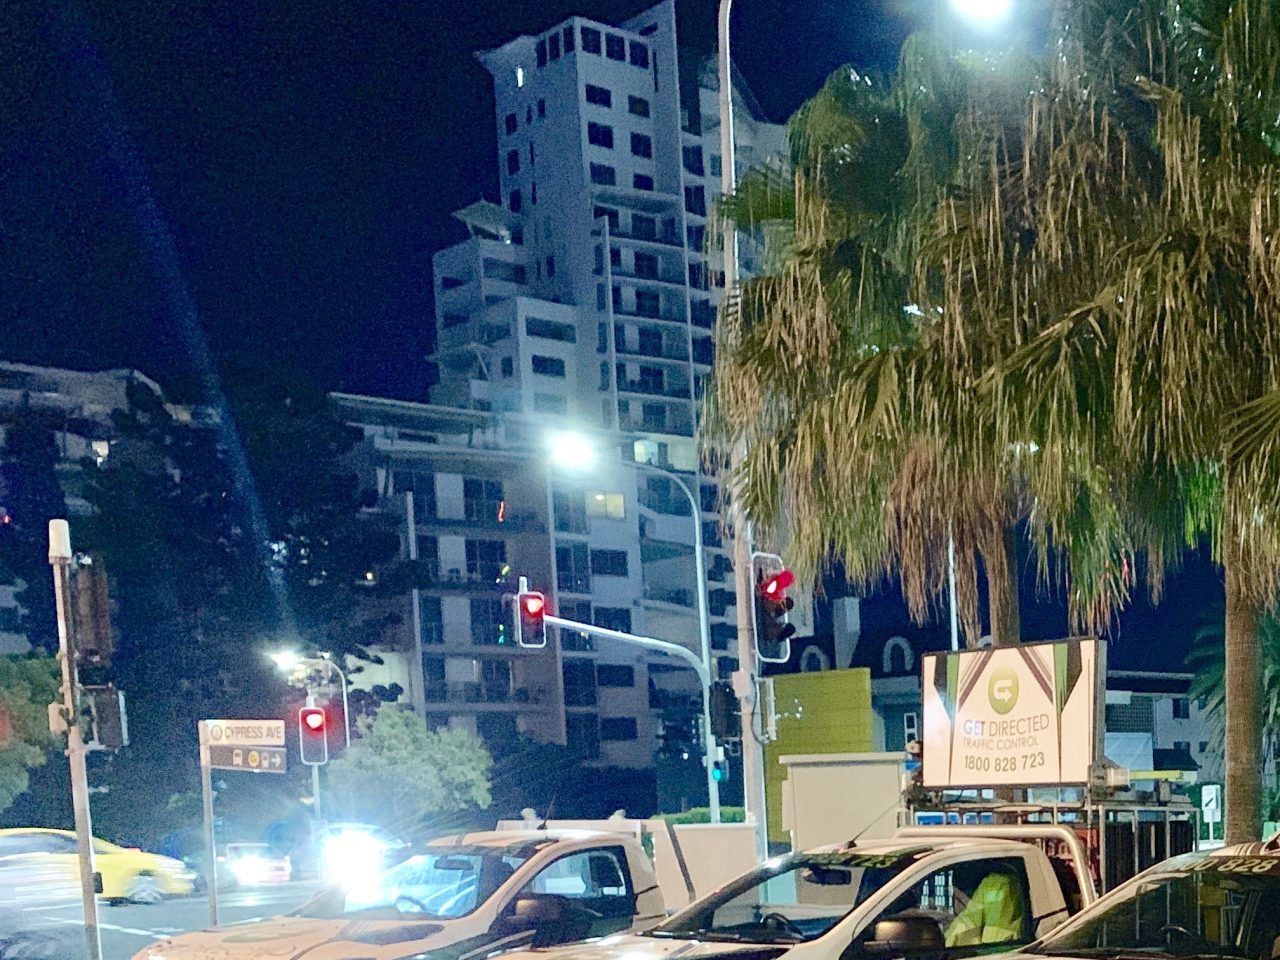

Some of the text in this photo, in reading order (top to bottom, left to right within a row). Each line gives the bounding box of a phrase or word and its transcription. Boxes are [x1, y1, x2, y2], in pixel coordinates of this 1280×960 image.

[225, 726, 281, 739] CYPRESS AVE
[963, 713, 1050, 737] GET DIRECTED
[963, 736, 1039, 750] TRAFFIC CONTROL
[965, 751, 1045, 772] 1800 828 723
[1217, 858, 1278, 873] 828
